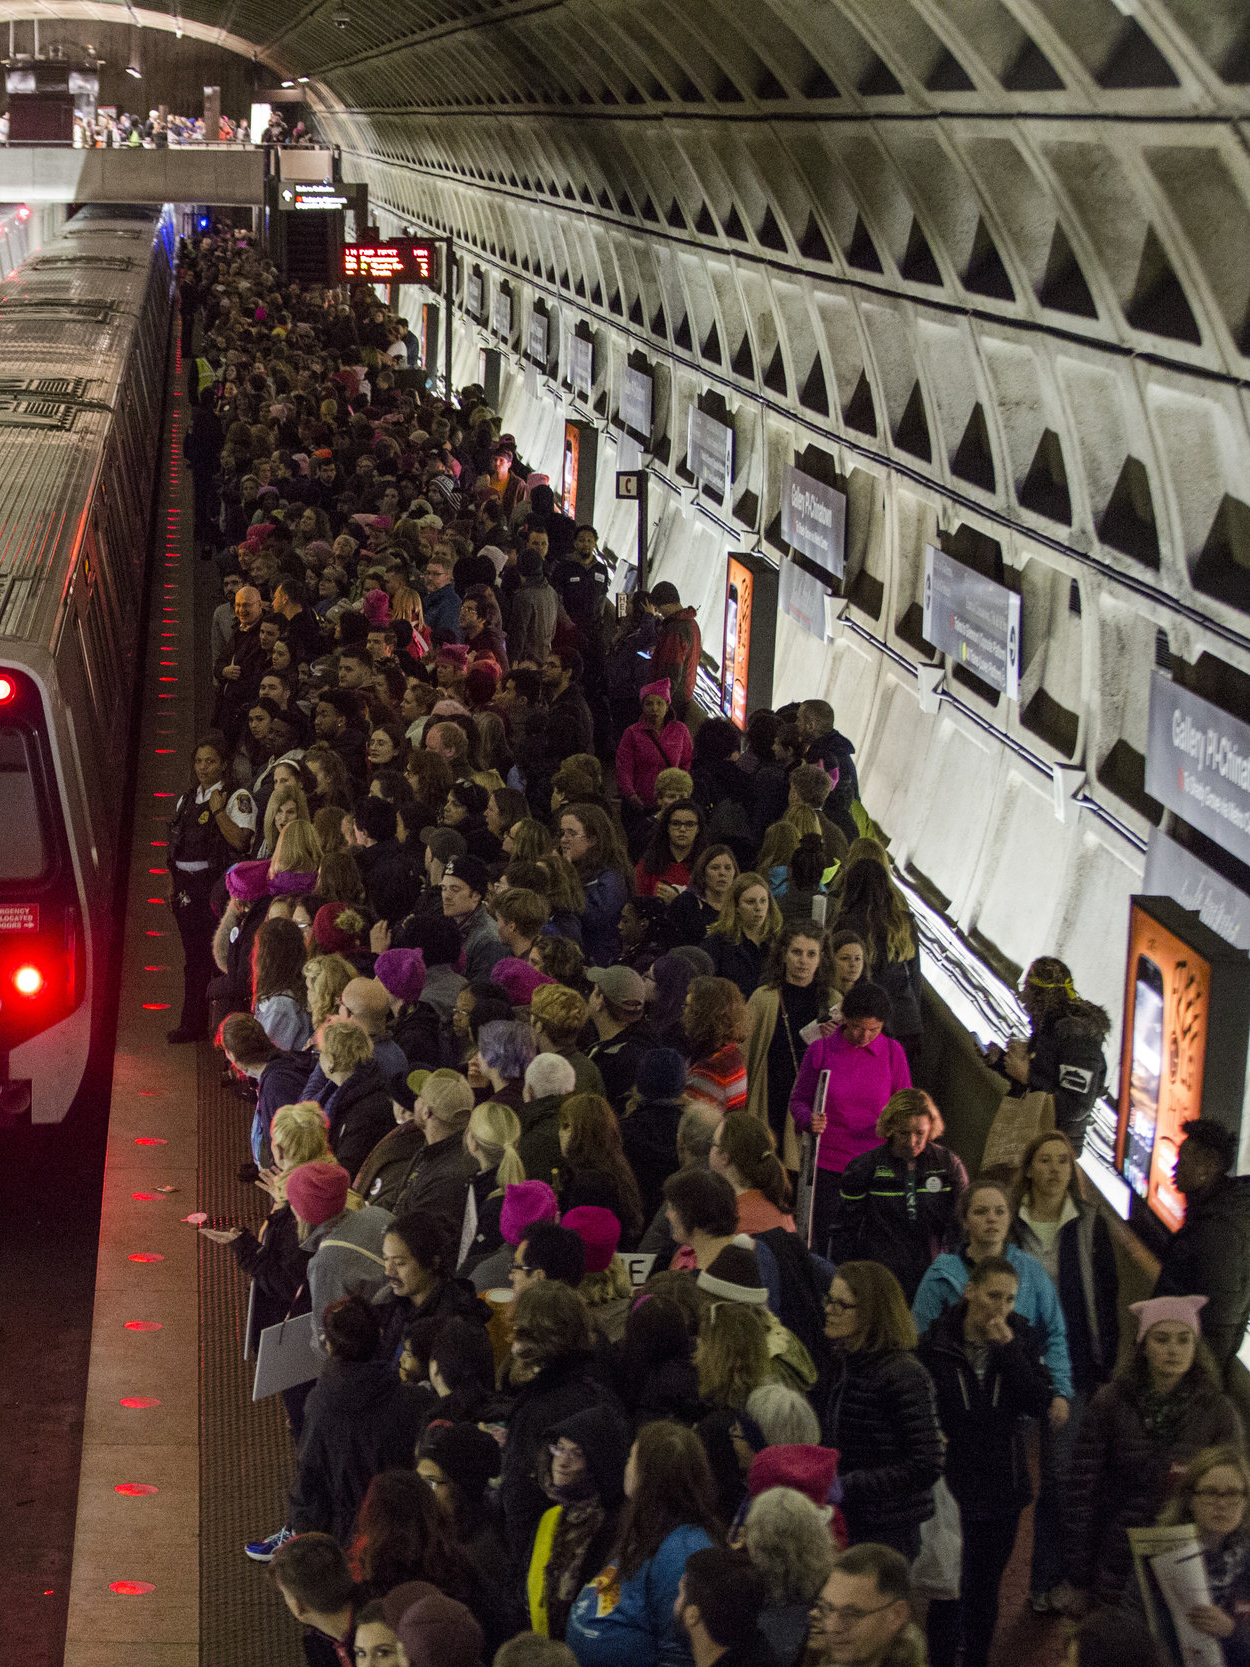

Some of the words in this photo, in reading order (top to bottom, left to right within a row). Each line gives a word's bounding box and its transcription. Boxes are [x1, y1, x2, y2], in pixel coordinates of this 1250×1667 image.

[625, 477, 632, 494] C
[1172, 708, 1205, 772] Gallery
[0, 914, 33, 922] LOCATED
[629, 1260, 645, 1287] E
